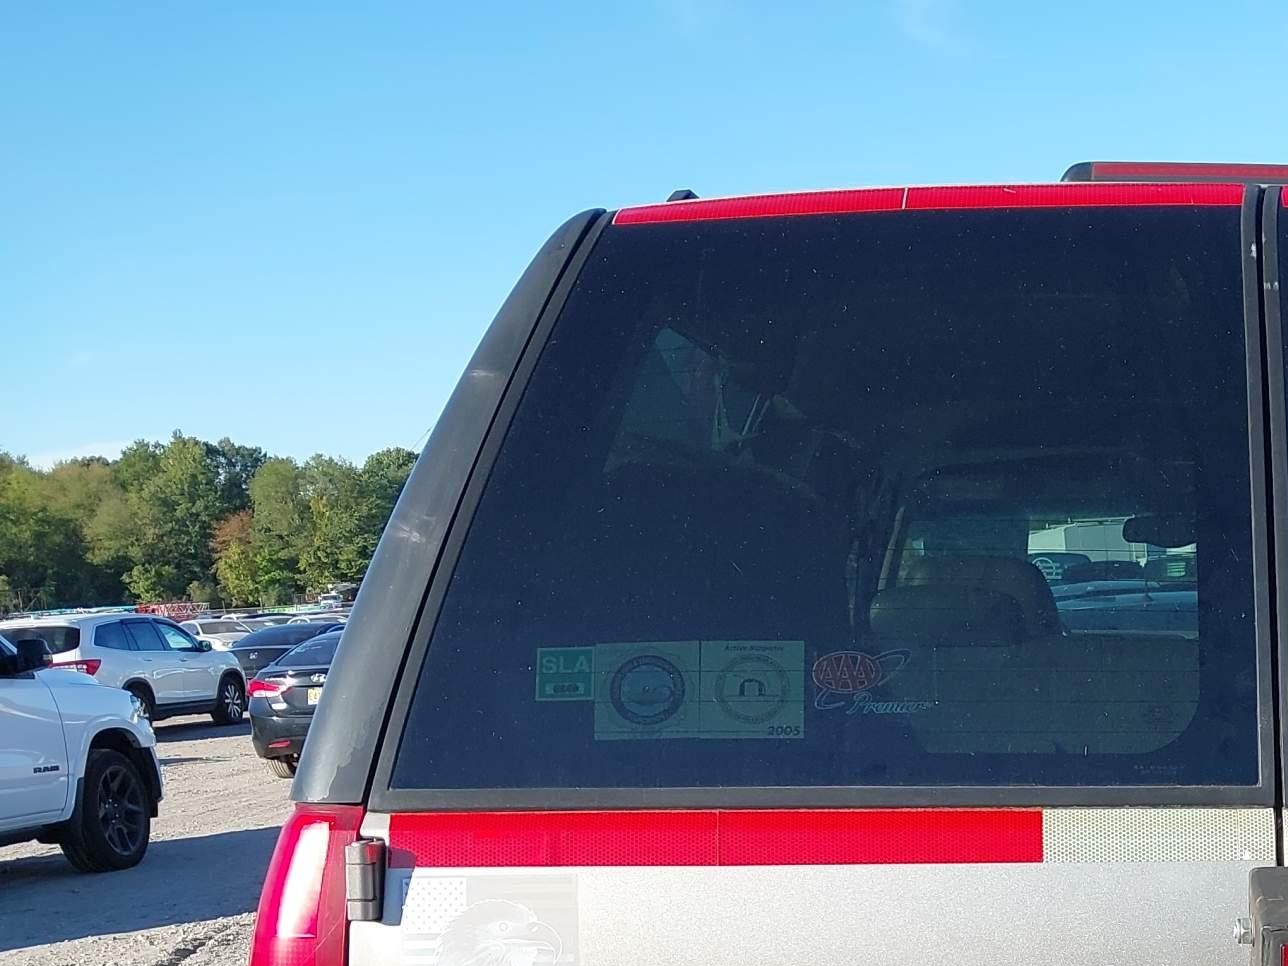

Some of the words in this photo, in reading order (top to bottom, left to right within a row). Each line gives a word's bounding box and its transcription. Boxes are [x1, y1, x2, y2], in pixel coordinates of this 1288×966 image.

[542, 655, 590, 673] SLA
[820, 655, 873, 690] AAA
[767, 726, 801, 736] 2005
